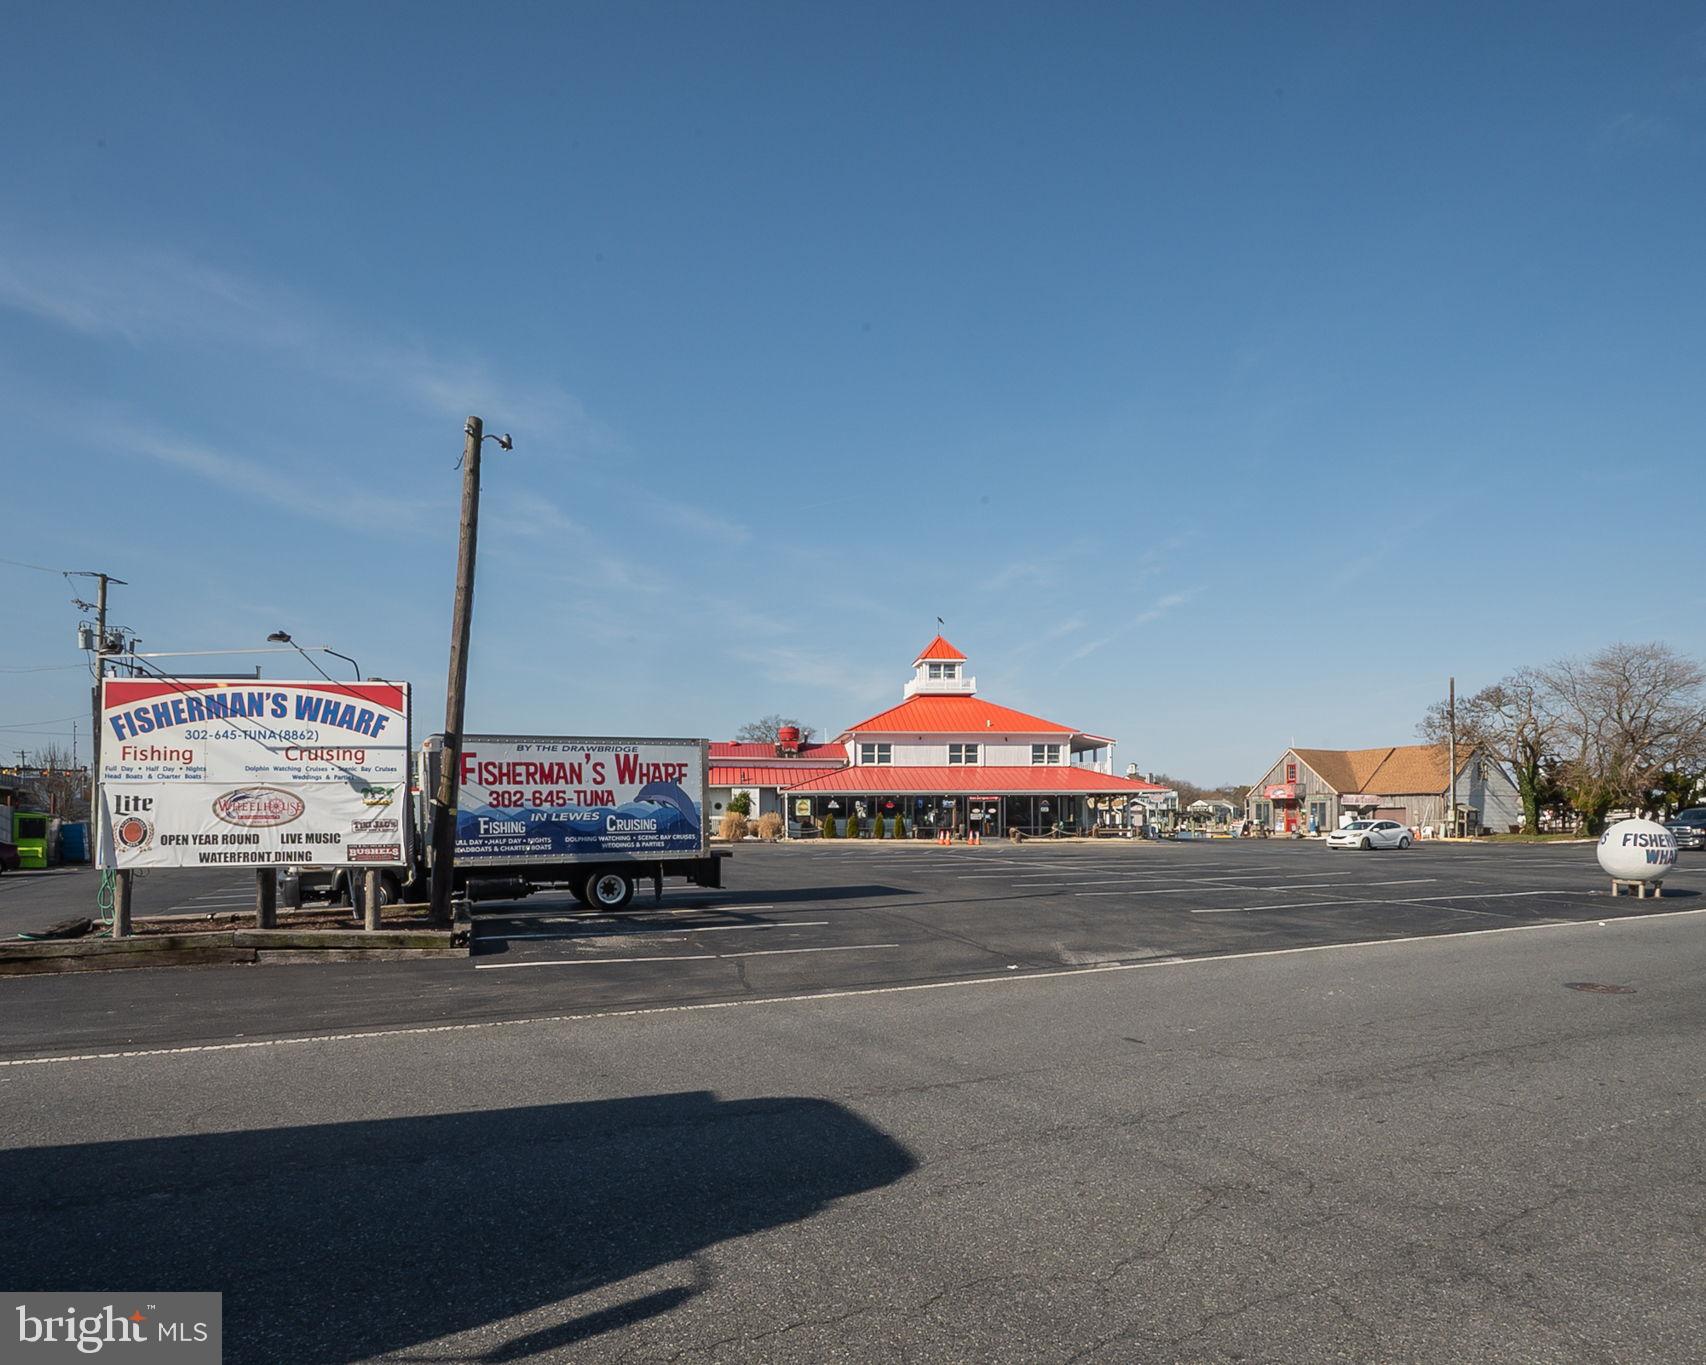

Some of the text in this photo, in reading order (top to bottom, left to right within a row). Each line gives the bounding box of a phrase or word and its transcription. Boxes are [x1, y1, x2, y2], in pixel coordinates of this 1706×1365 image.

[109, 692, 390, 741] FISHERMAN'S WHARF
[185, 729, 319, 742] 302-645-TUNA(8862)
[122, 745, 193, 765] Fishing
[285, 745, 365, 765] Cruising
[516, 744, 639, 753] BY THE DRAWBRIDGE
[121, 765, 134, 773] Day
[163, 765, 176, 773] Day
[186, 765, 207, 773] Nights
[245, 765, 270, 773] Dolphin
[273, 765, 302, 773] Watching
[361, 765, 372, 773] Bay
[114, 794, 154, 816] Lite
[488, 789, 616, 808] 302-645-TUNA
[530, 811, 600, 821] IN LEWES
[160, 833, 260, 846] OPEN YEAR ROUND
[280, 832, 341, 845] LIVE MUSIC
[1622, 832, 1677, 848] FISHER
[348, 847, 400, 857] BUSHELS
[531, 843, 552, 851] BOATS
[199, 850, 313, 863] WATERFRONT DINING
